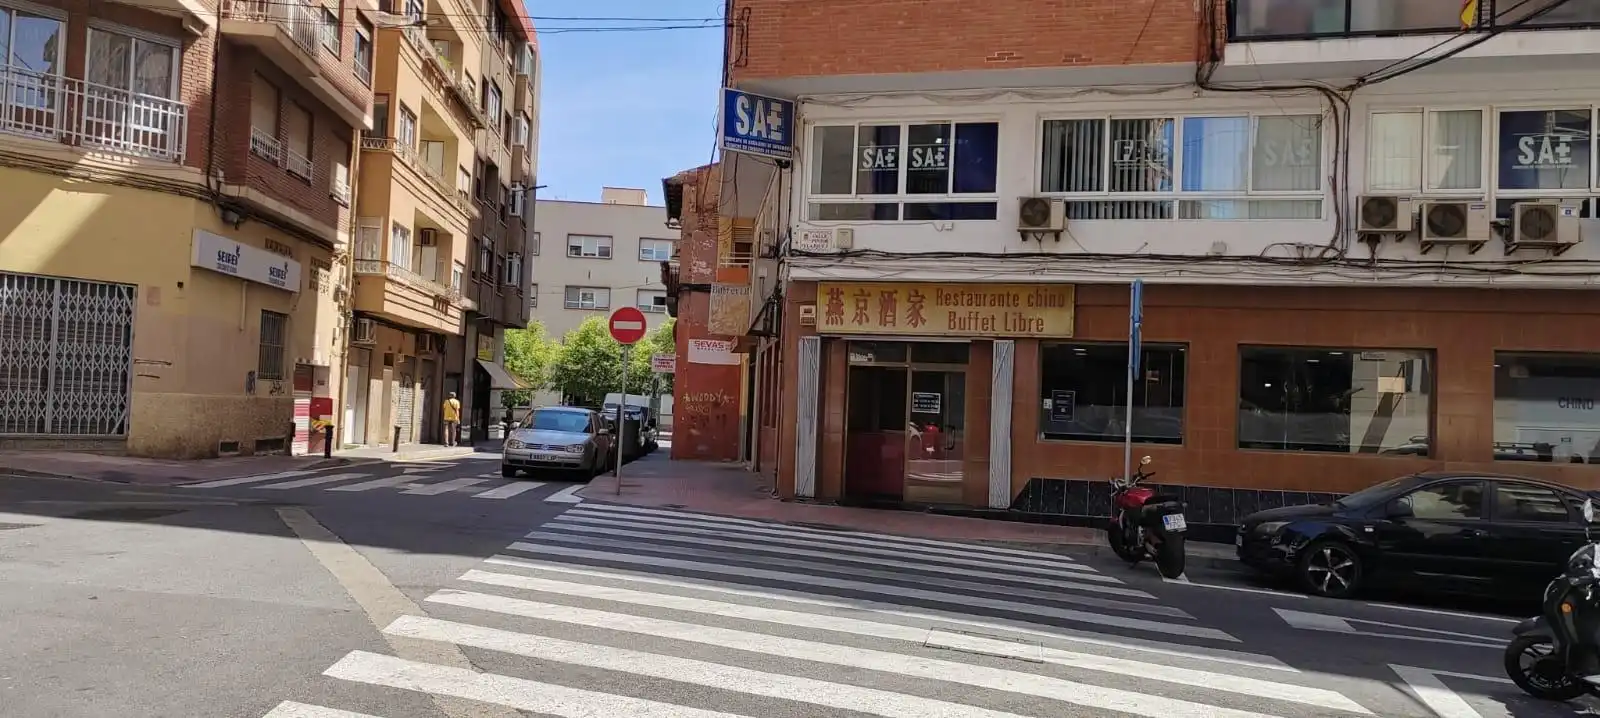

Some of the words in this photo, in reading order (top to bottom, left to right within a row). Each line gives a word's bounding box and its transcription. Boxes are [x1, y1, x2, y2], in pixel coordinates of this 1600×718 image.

[936, 287, 1020, 307] Restaurante
[1027, 289, 1066, 308] chino
[947, 310, 997, 332] Buffet
[1004, 311, 1044, 333] Libre
[1558, 396, 1594, 410] CHINO
